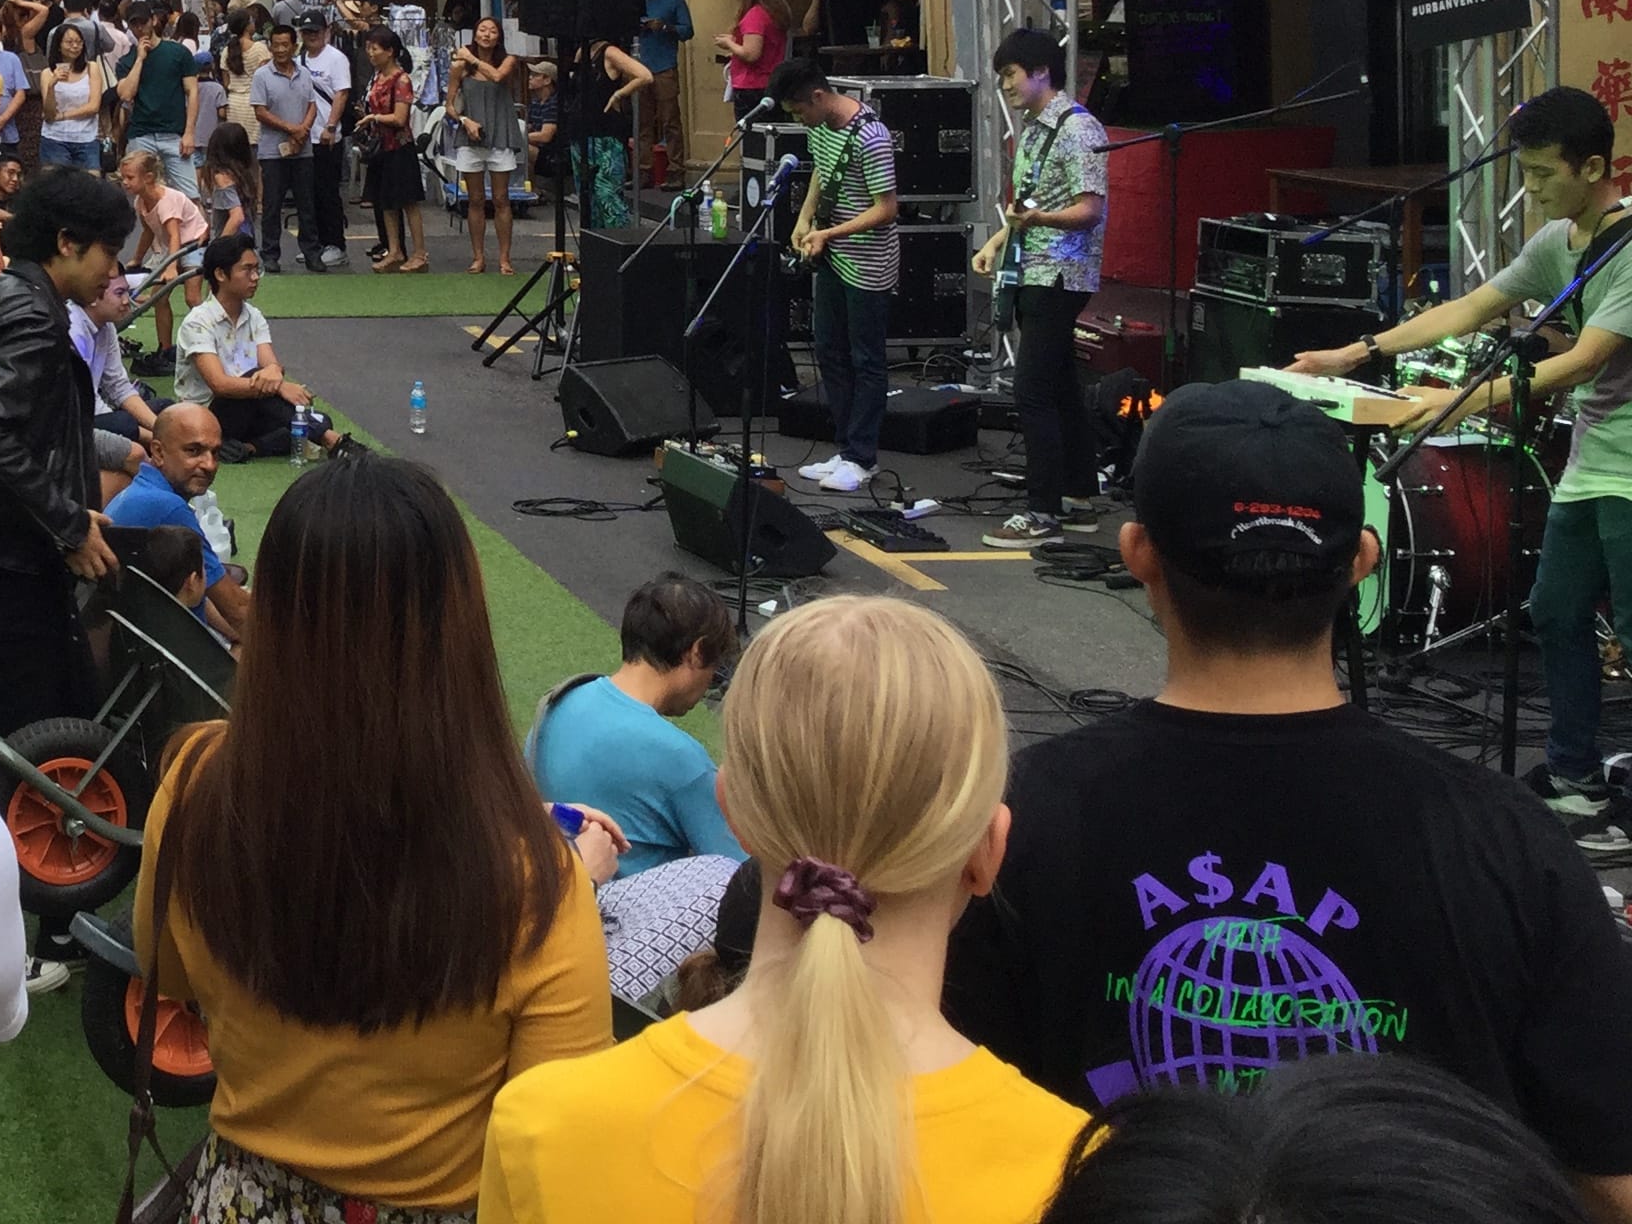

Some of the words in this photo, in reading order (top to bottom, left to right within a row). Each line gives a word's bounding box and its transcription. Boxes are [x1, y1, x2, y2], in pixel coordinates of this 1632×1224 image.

[1132, 850, 1361, 936] A$AP
[1106, 972, 1137, 1005] IN
[1148, 977, 1166, 1007] A
[1176, 979, 1408, 1042] COLLABORATION
